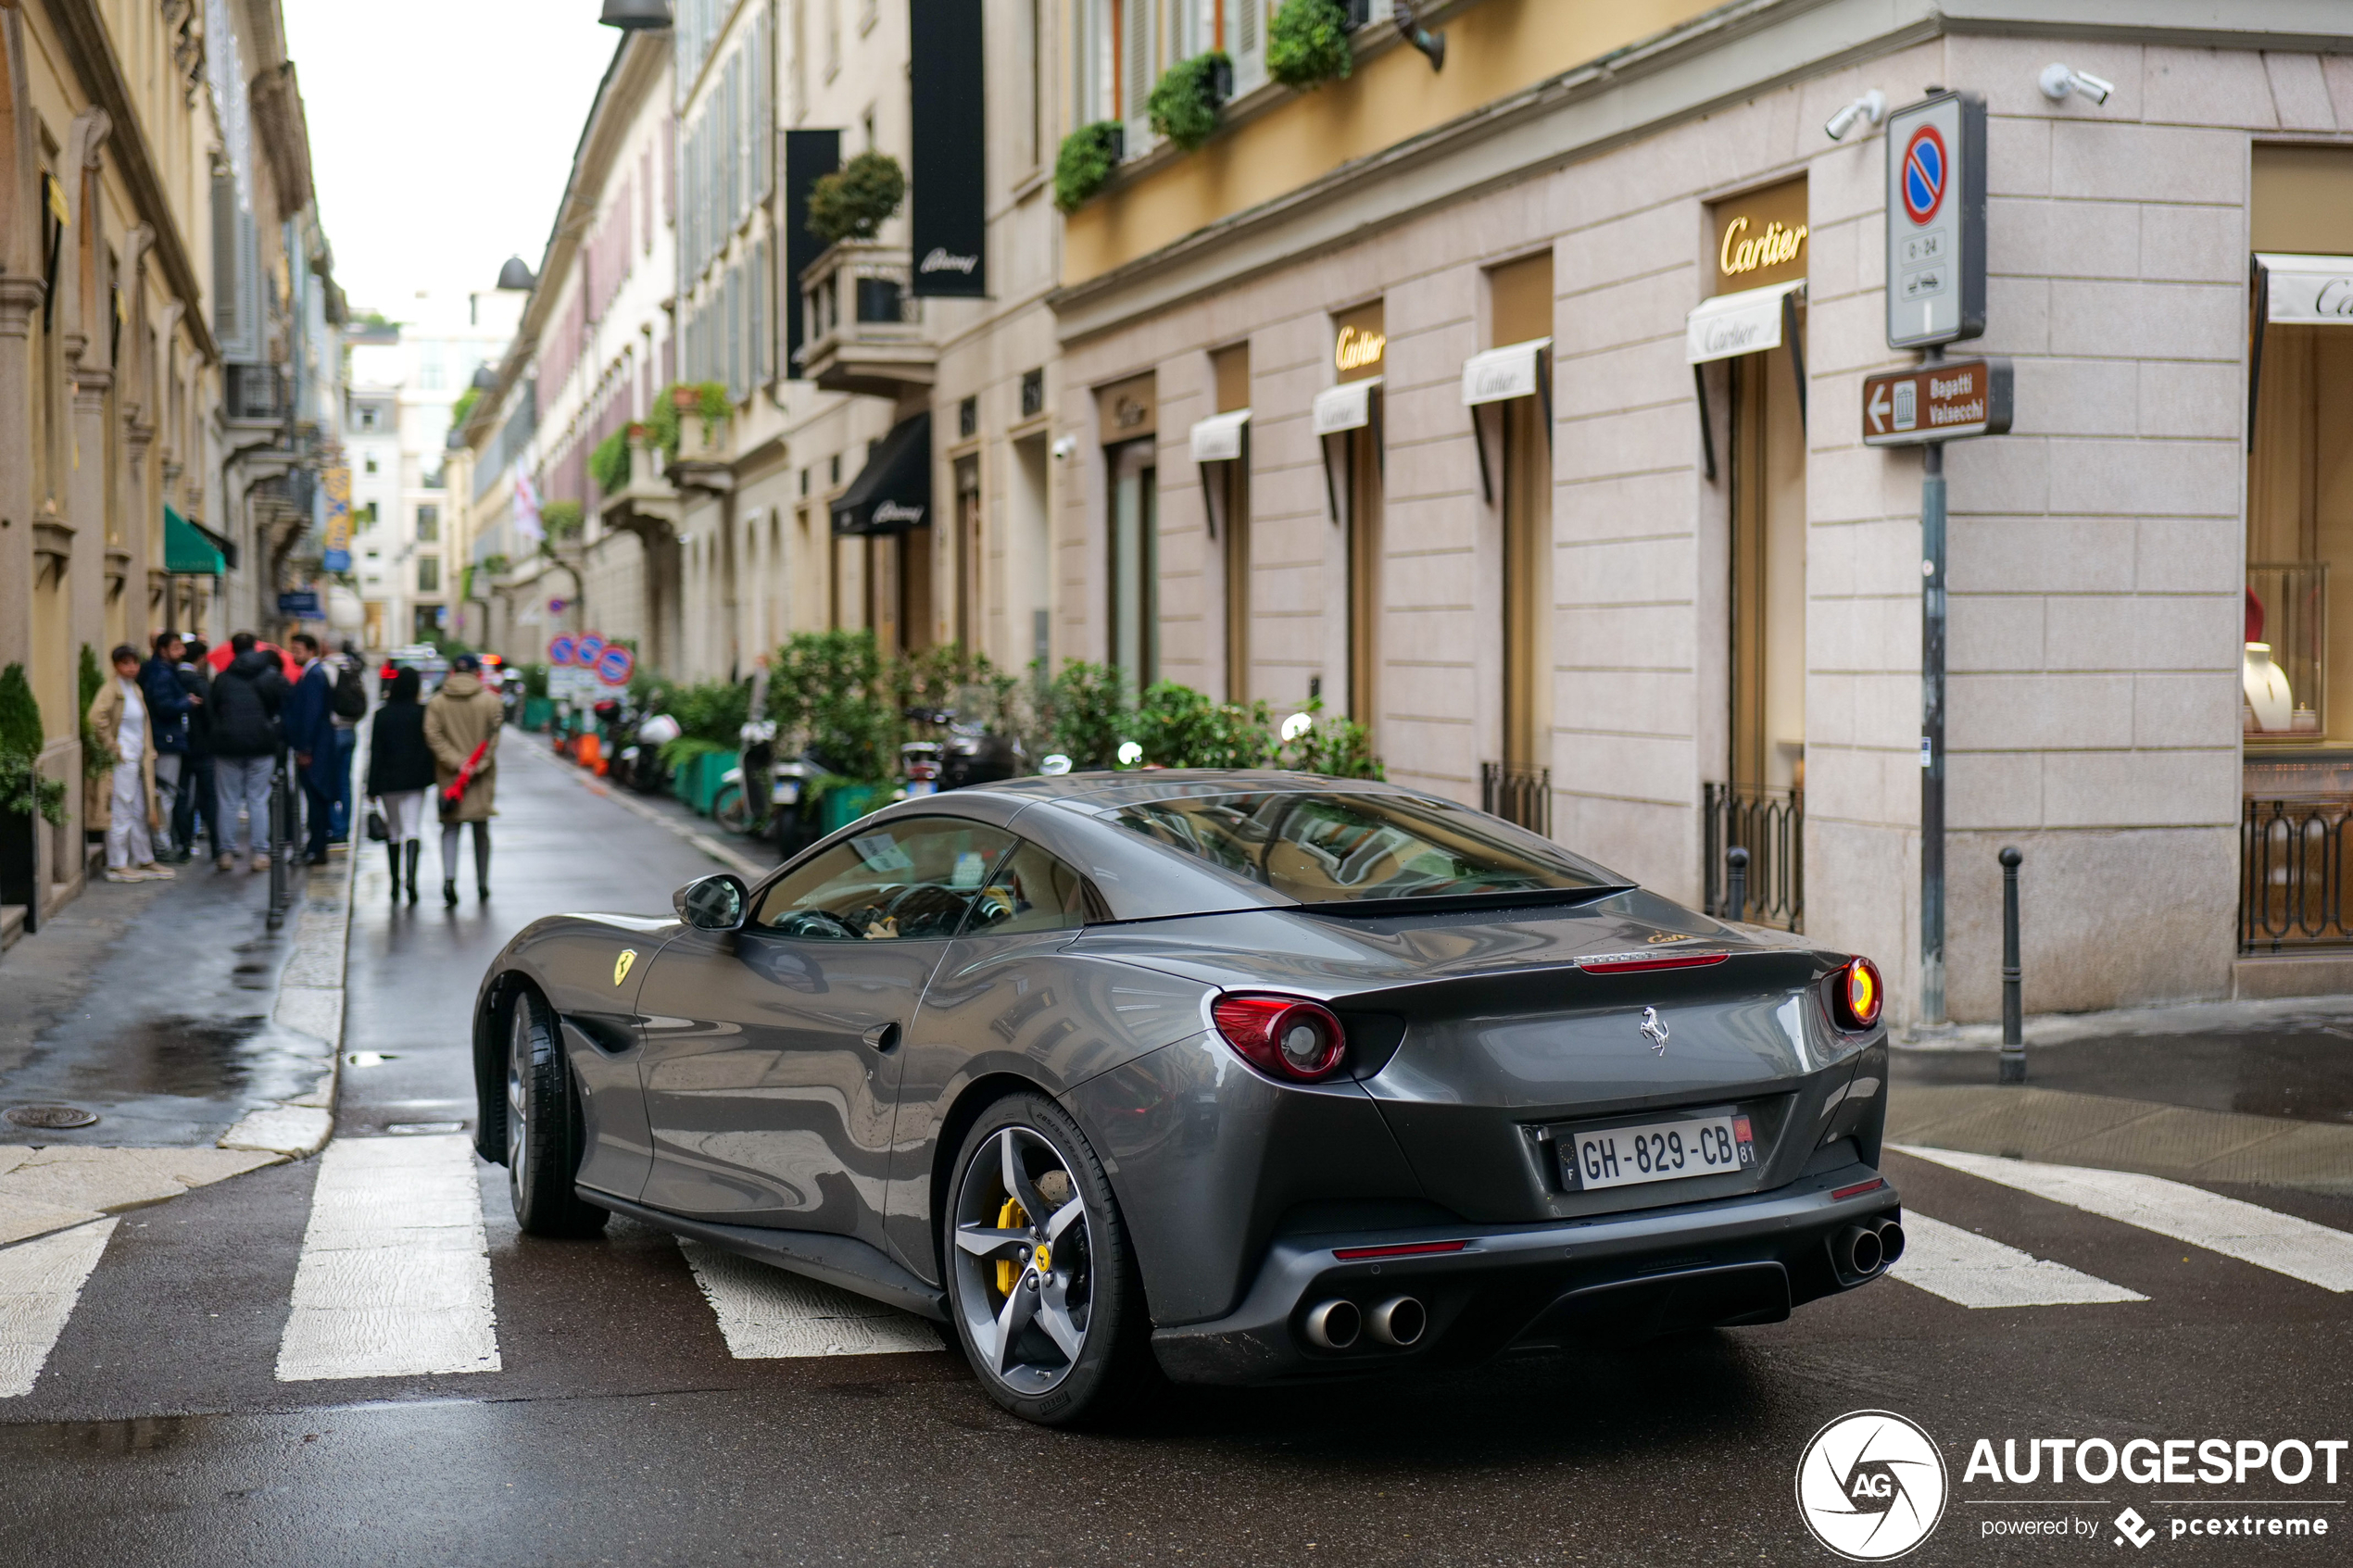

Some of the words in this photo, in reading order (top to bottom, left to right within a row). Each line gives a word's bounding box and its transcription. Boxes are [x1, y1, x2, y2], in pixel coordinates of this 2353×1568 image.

[1720, 216, 1808, 276] Cartier
[1929, 371, 1973, 401] Bagatti
[1929, 397, 1984, 426] Valsecchi
[1582, 1124, 1734, 1181] GH-829-CB
[1739, 1145, 1756, 1164] 81
[1567, 1168, 1575, 1181] F
[1038, 1390, 1073, 1417] PIRELLI
